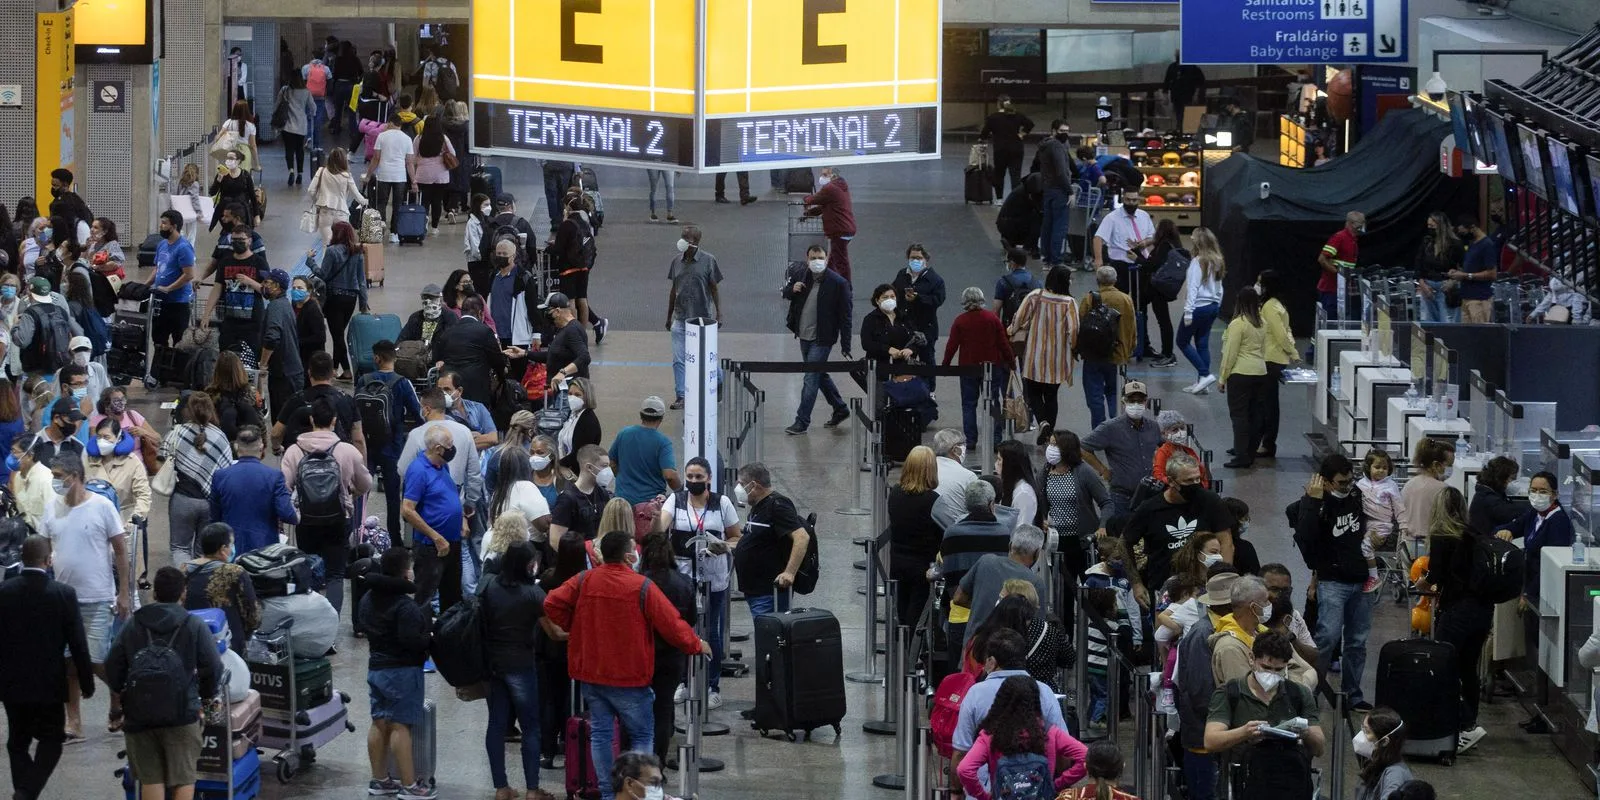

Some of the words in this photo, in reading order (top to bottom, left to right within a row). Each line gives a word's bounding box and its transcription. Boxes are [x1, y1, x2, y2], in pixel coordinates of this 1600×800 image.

[1242, 9, 1315, 20] Restrooms
[44, 28, 52, 55] Check-in
[561, 0, 603, 64] E
[802, 0, 847, 64] E
[1275, 30, 1338, 42] Fraldário
[1250, 46, 1283, 61] Baby
[1288, 45, 1338, 60] change
[508, 109, 640, 153] TERMINAL
[647, 120, 664, 155] 2
[737, 115, 877, 155] TERMINAL
[884, 113, 901, 147] 2
[1336, 513, 1354, 528] NIKE
[1351, 521, 1361, 533] SB
[251, 671, 284, 688] OTVS
